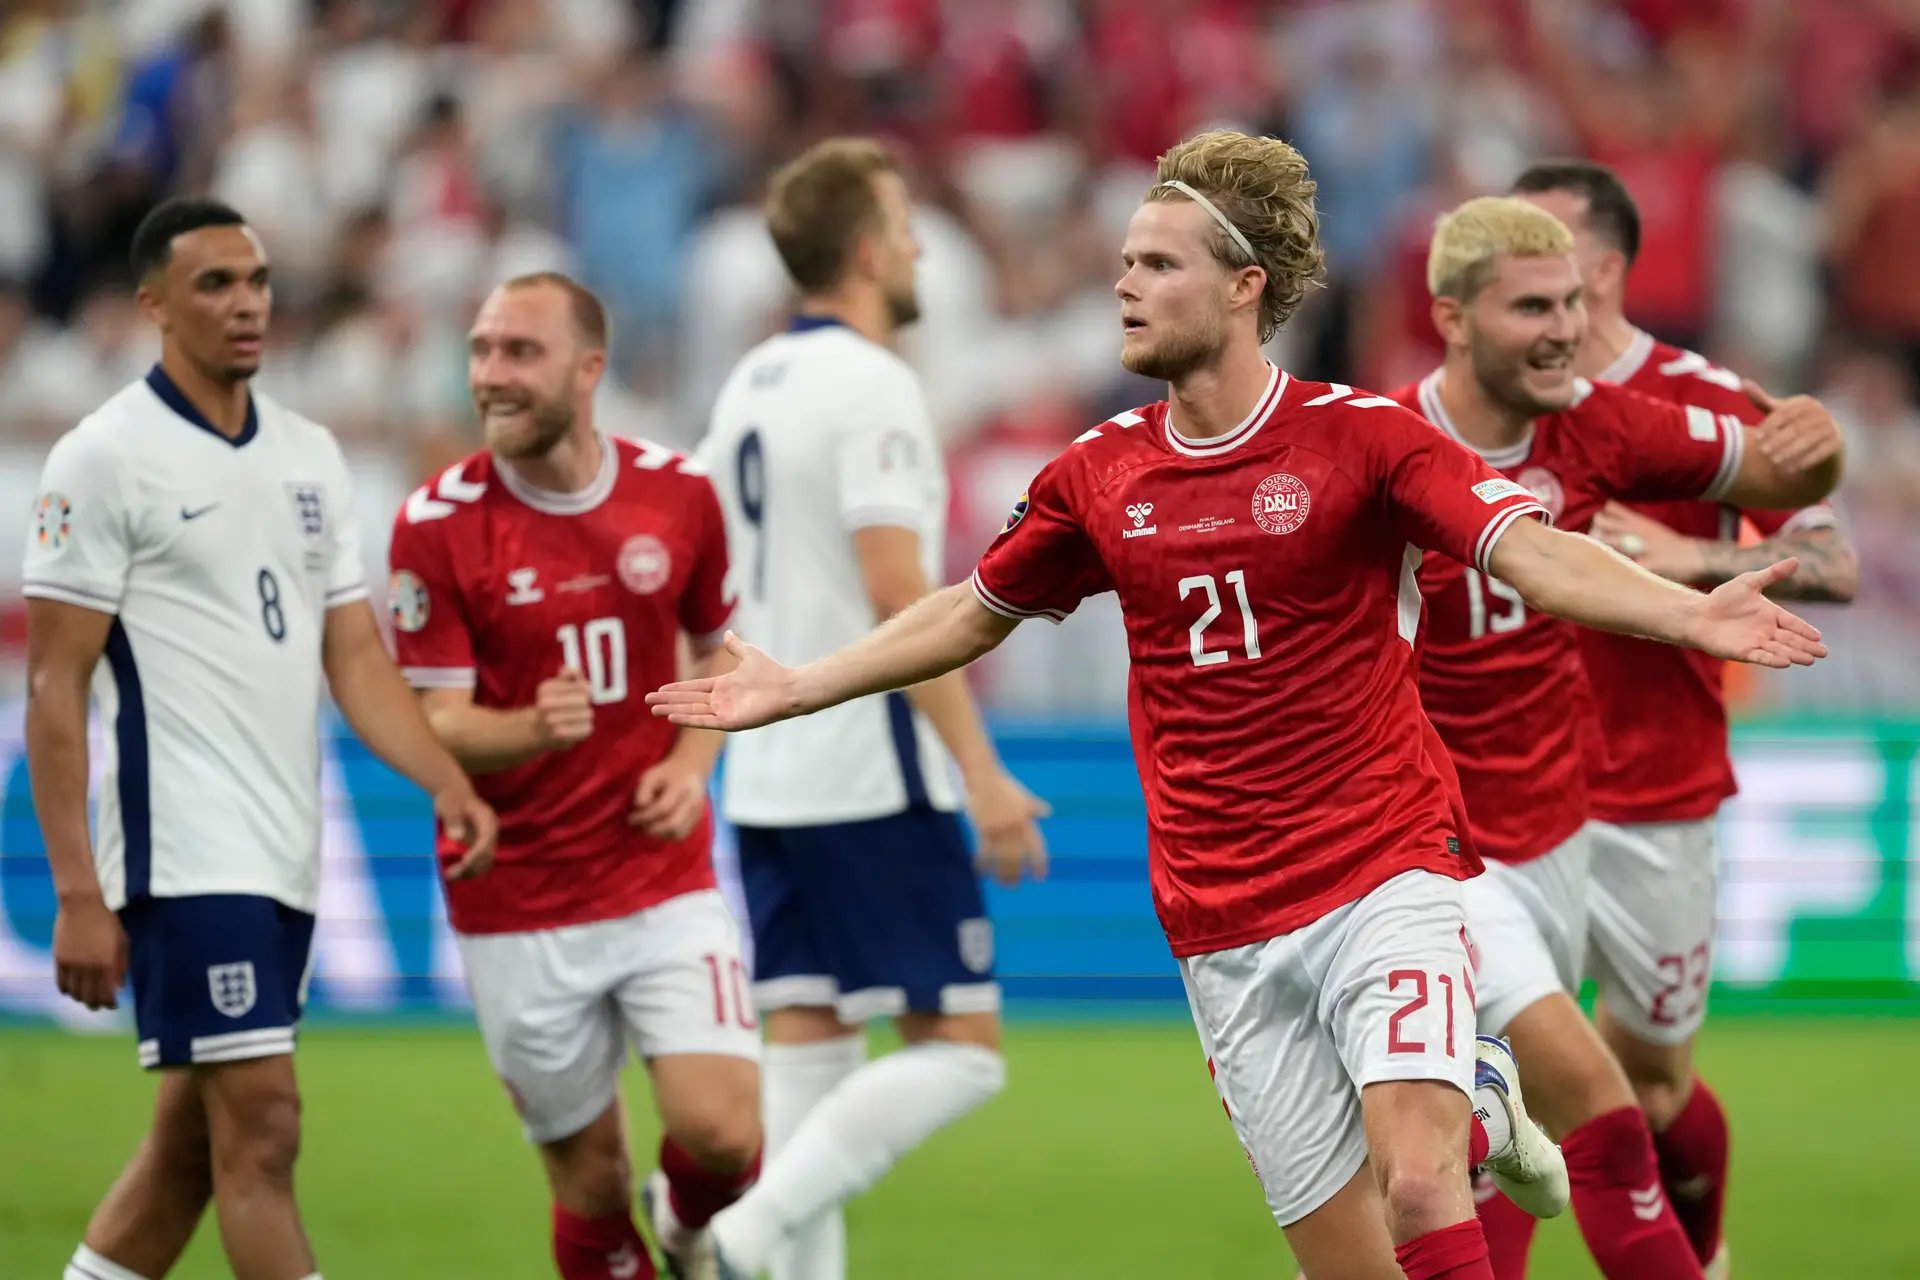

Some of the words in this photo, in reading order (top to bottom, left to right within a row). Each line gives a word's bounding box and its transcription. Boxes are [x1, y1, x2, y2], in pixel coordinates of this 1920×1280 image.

[1253, 493, 1269, 529] DANSK
[1263, 493, 1298, 513] DBU
[1294, 490, 1309, 524] UNION
[1123, 524, 1157, 539] hummel
[1178, 522, 1204, 532] DENMARK
[1210, 517, 1235, 527] ENGLAND
[1270, 524, 1294, 533] 1889
[256, 566, 286, 642] 8
[1178, 569, 1262, 667] 21
[556, 616, 629, 706] 10
[702, 952, 759, 1031] 10
[1388, 969, 1455, 1059] 21
